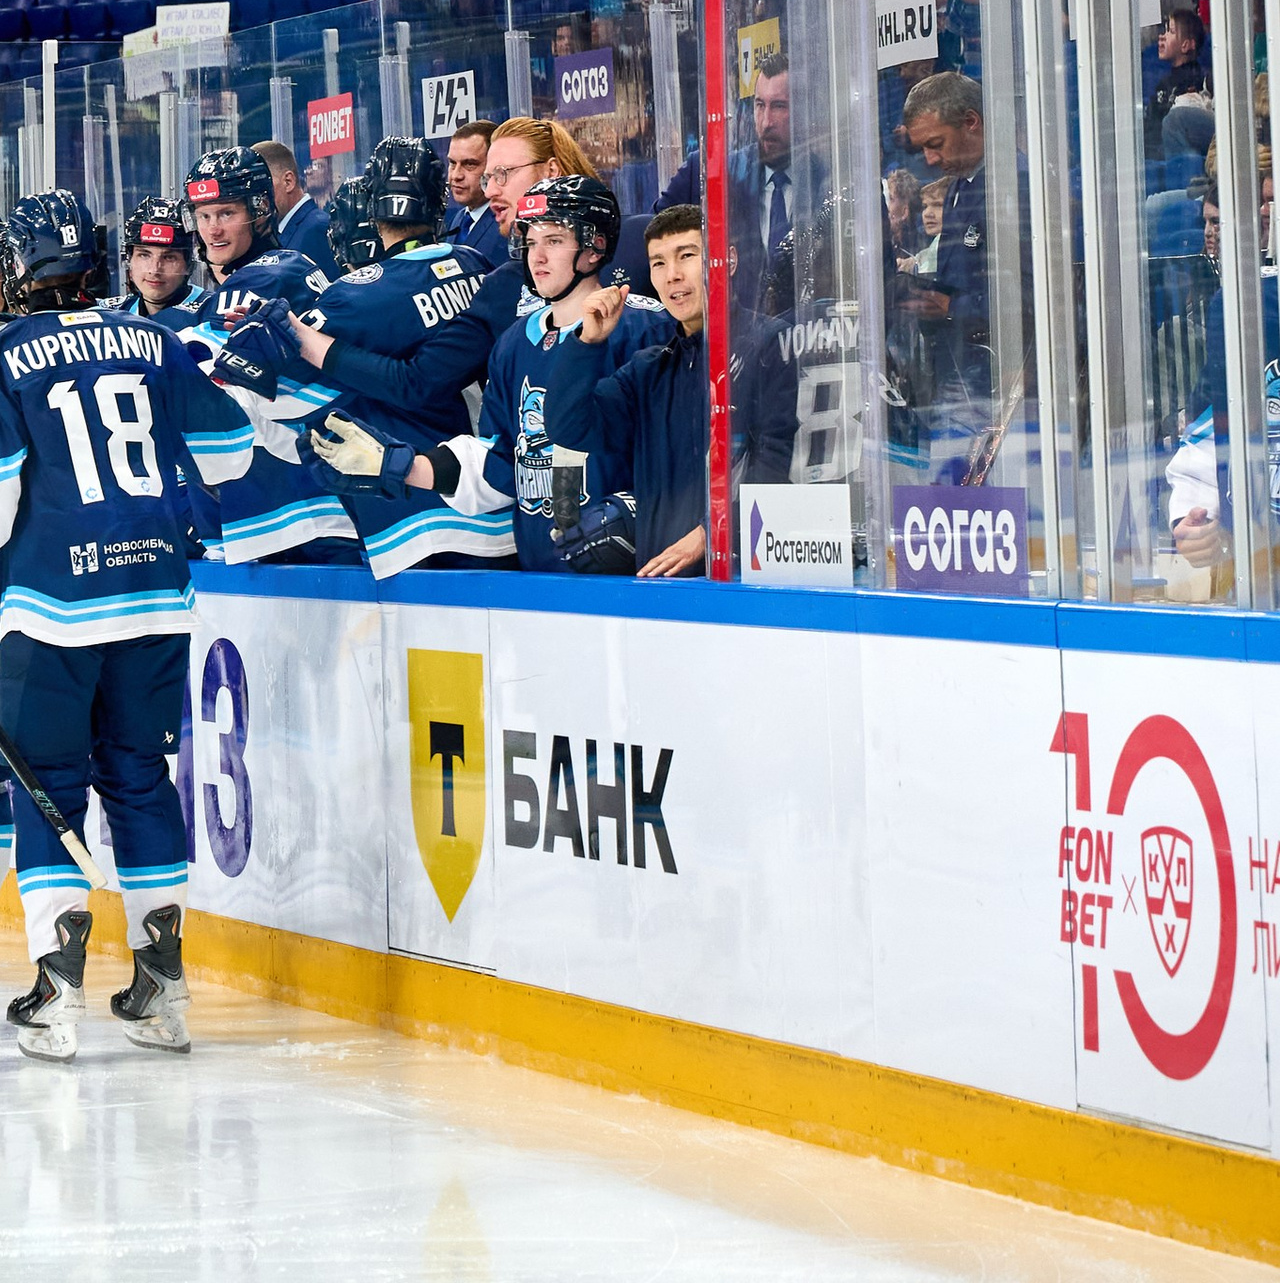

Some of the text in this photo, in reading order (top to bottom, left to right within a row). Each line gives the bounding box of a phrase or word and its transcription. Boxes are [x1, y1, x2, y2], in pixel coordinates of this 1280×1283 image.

[878, 4, 933, 48] KHL.RU
[309, 107, 353, 146] FONBET
[391, 198, 408, 216] 17
[60, 224, 78, 246] 18
[365, 241, 376, 258] 7
[4, 326, 163, 380] KUPRIYANOV
[47, 373, 164, 505] 18
[106, 552, 158, 568] ОБЛАСТЬ
[766, 531, 842, 565] Ростелеком
[502, 729, 679, 875] БАНК
[1058, 824, 1114, 885] FON
[1059, 888, 1114, 950] BET
